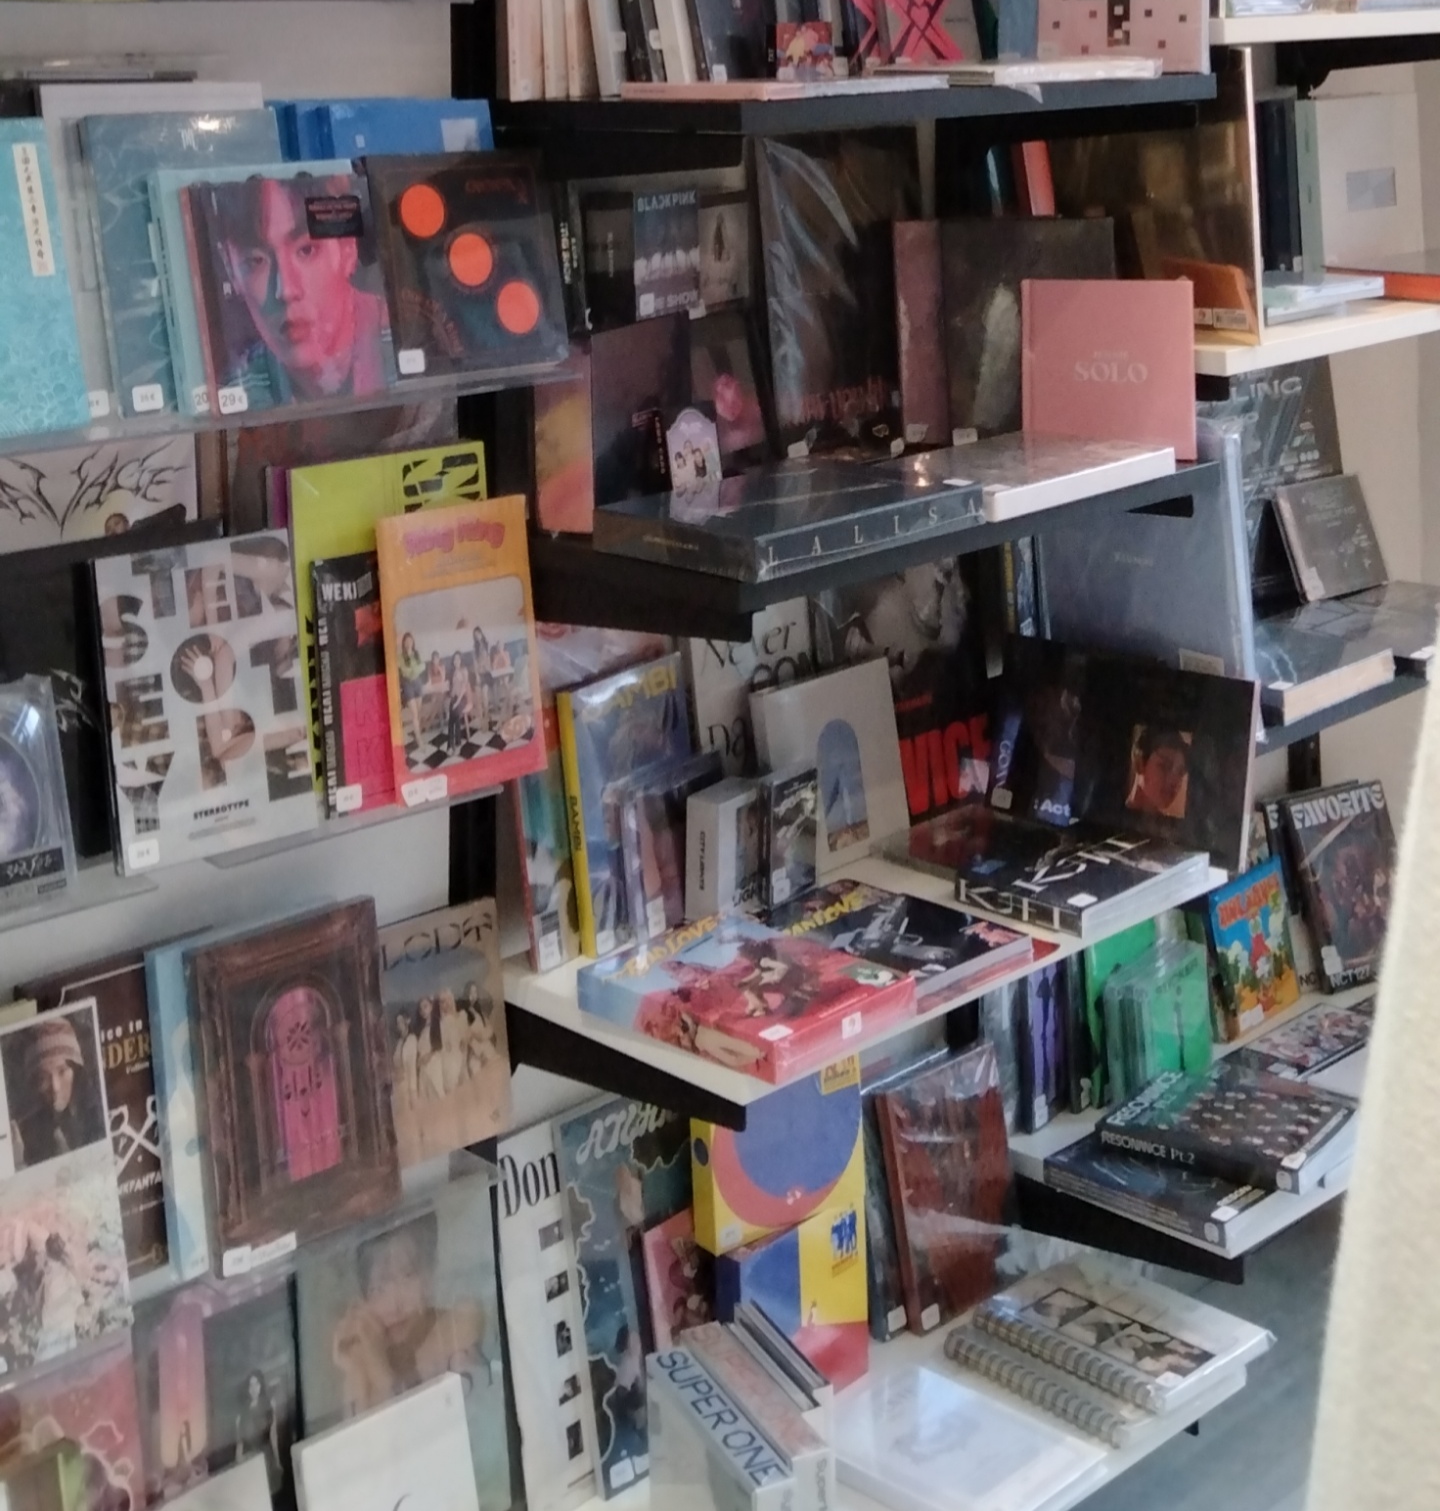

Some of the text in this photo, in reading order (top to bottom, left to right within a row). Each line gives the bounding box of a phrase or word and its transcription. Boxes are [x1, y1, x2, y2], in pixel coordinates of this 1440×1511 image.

[637, 189, 697, 213] BLACKPINK
[1074, 359, 1149, 385] SOLO
[193, 799, 250, 821] STEREOTYPE
[1290, 784, 1385, 830] FAVORITE
[1101, 1130, 1196, 1165] RESONANCE Pt.2
[501, 1149, 561, 1219] Don
[656, 1350, 790, 1487] SUPER ONE
